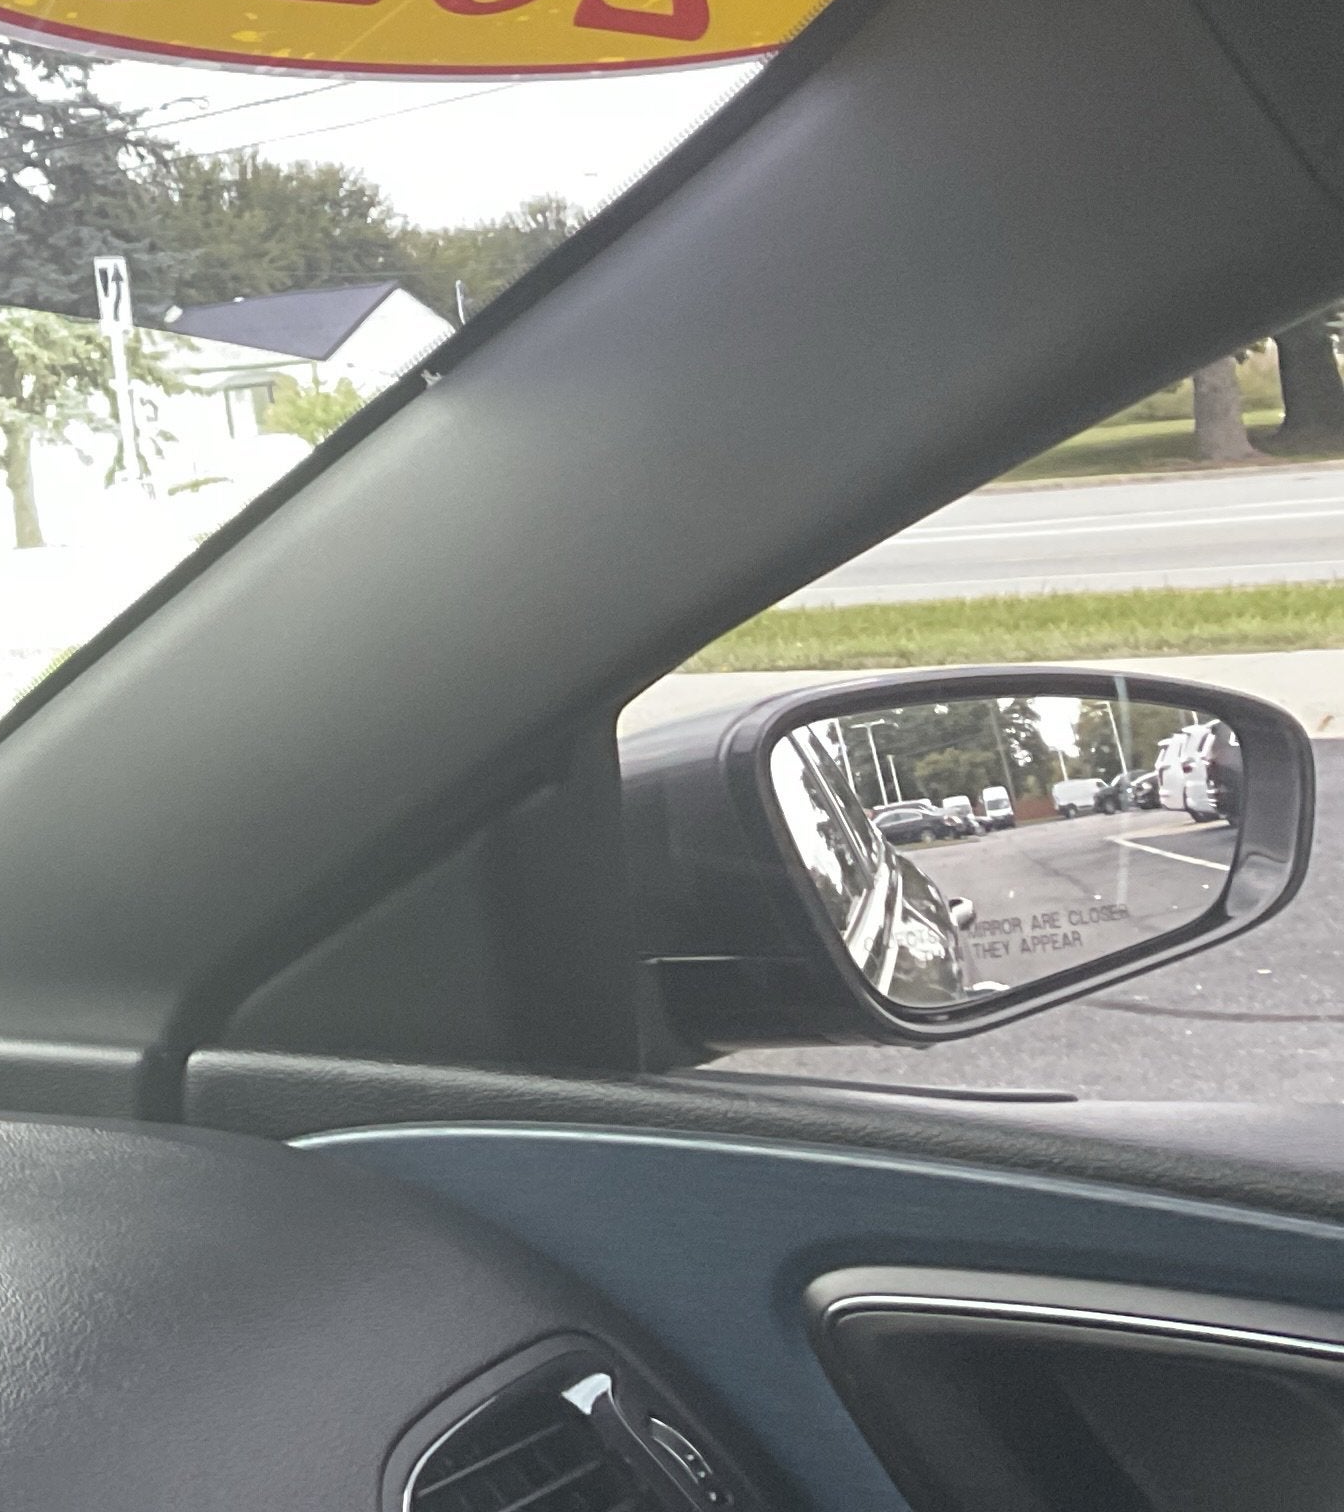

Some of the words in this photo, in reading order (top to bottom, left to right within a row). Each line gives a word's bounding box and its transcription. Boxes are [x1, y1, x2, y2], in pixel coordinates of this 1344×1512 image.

[1031, 912, 1062, 931] ARE
[1068, 904, 1130, 927] CLOSER
[972, 941, 1010, 960] THEY
[1020, 932, 1084, 955] APPEAR
